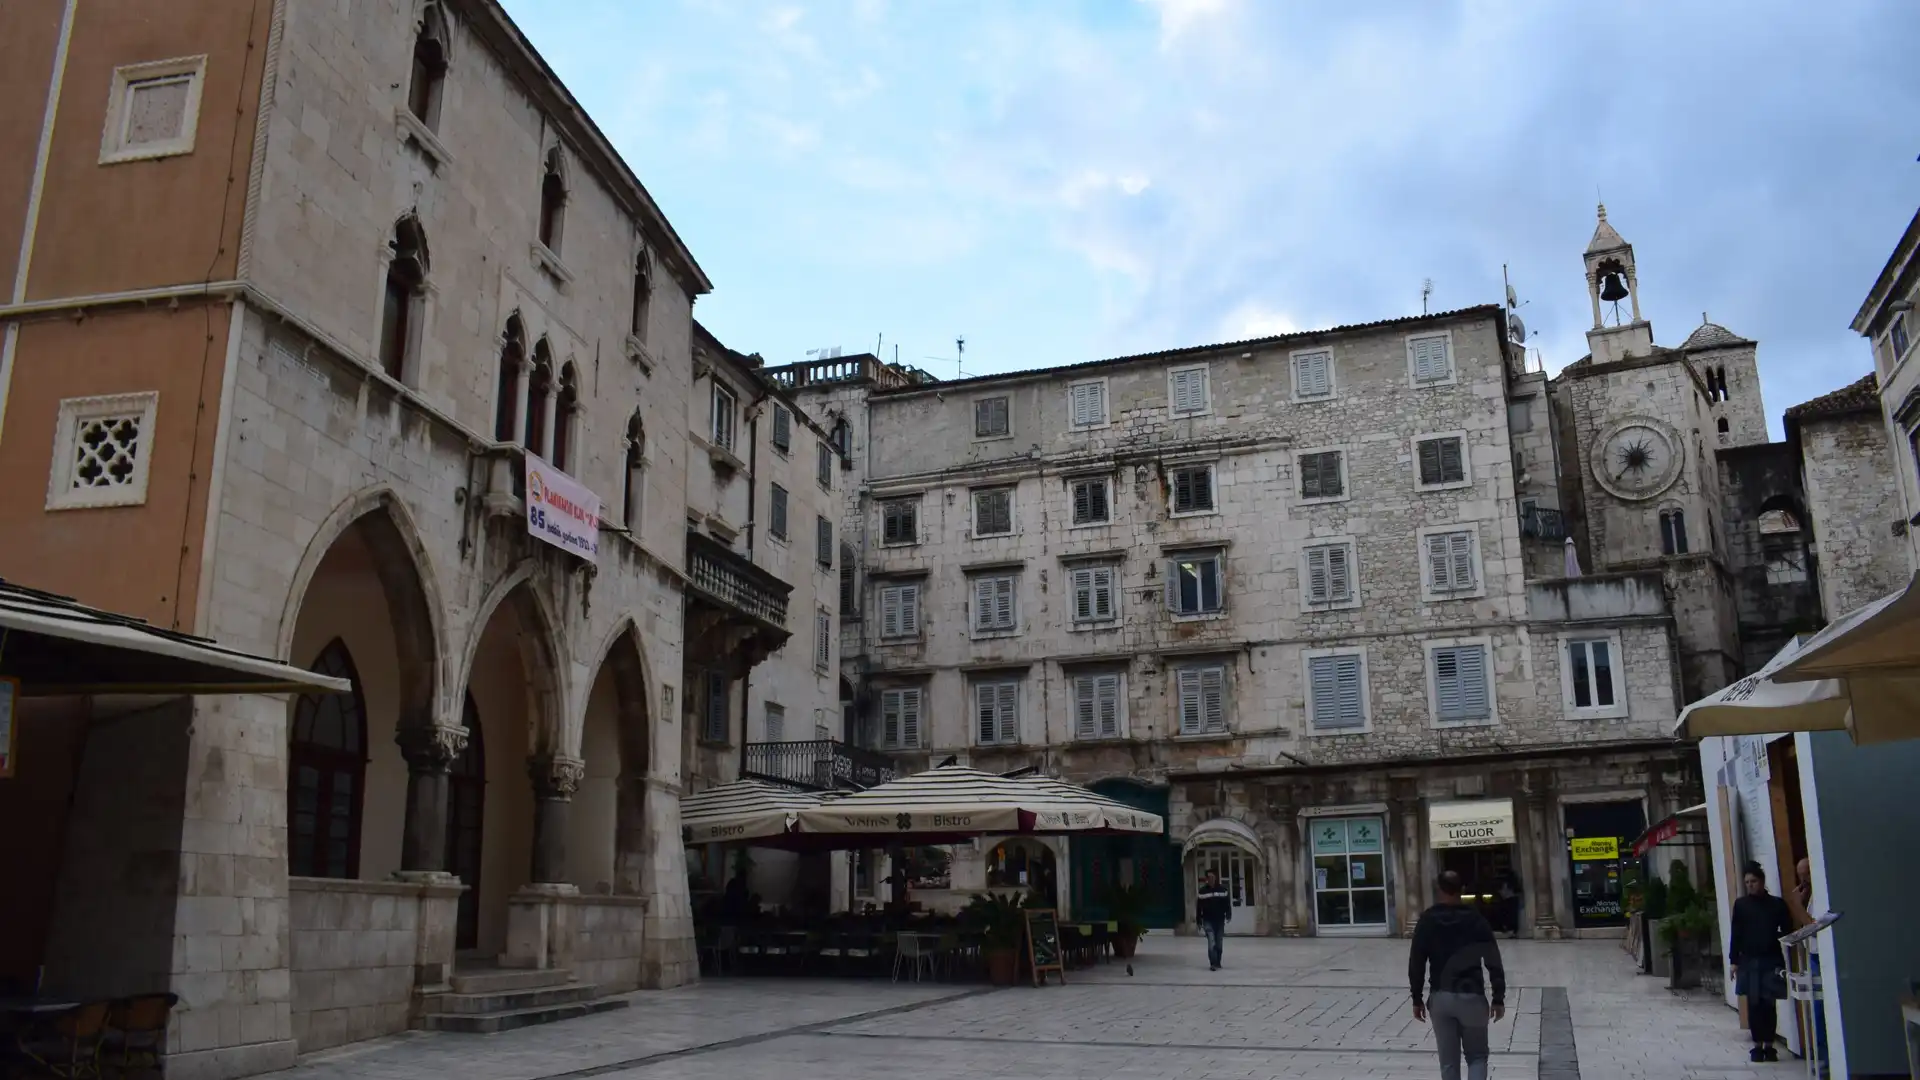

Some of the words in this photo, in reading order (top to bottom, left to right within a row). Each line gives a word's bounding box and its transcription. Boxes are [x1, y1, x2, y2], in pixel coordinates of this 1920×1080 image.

[530, 506, 545, 529] 85
[933, 814, 971, 827] Bistro
[711, 824, 745, 837] Bistro
[1449, 827, 1495, 839] LIQUOR
[1575, 845, 1614, 855] Exchange
[1580, 905, 1621, 914] Exchange
